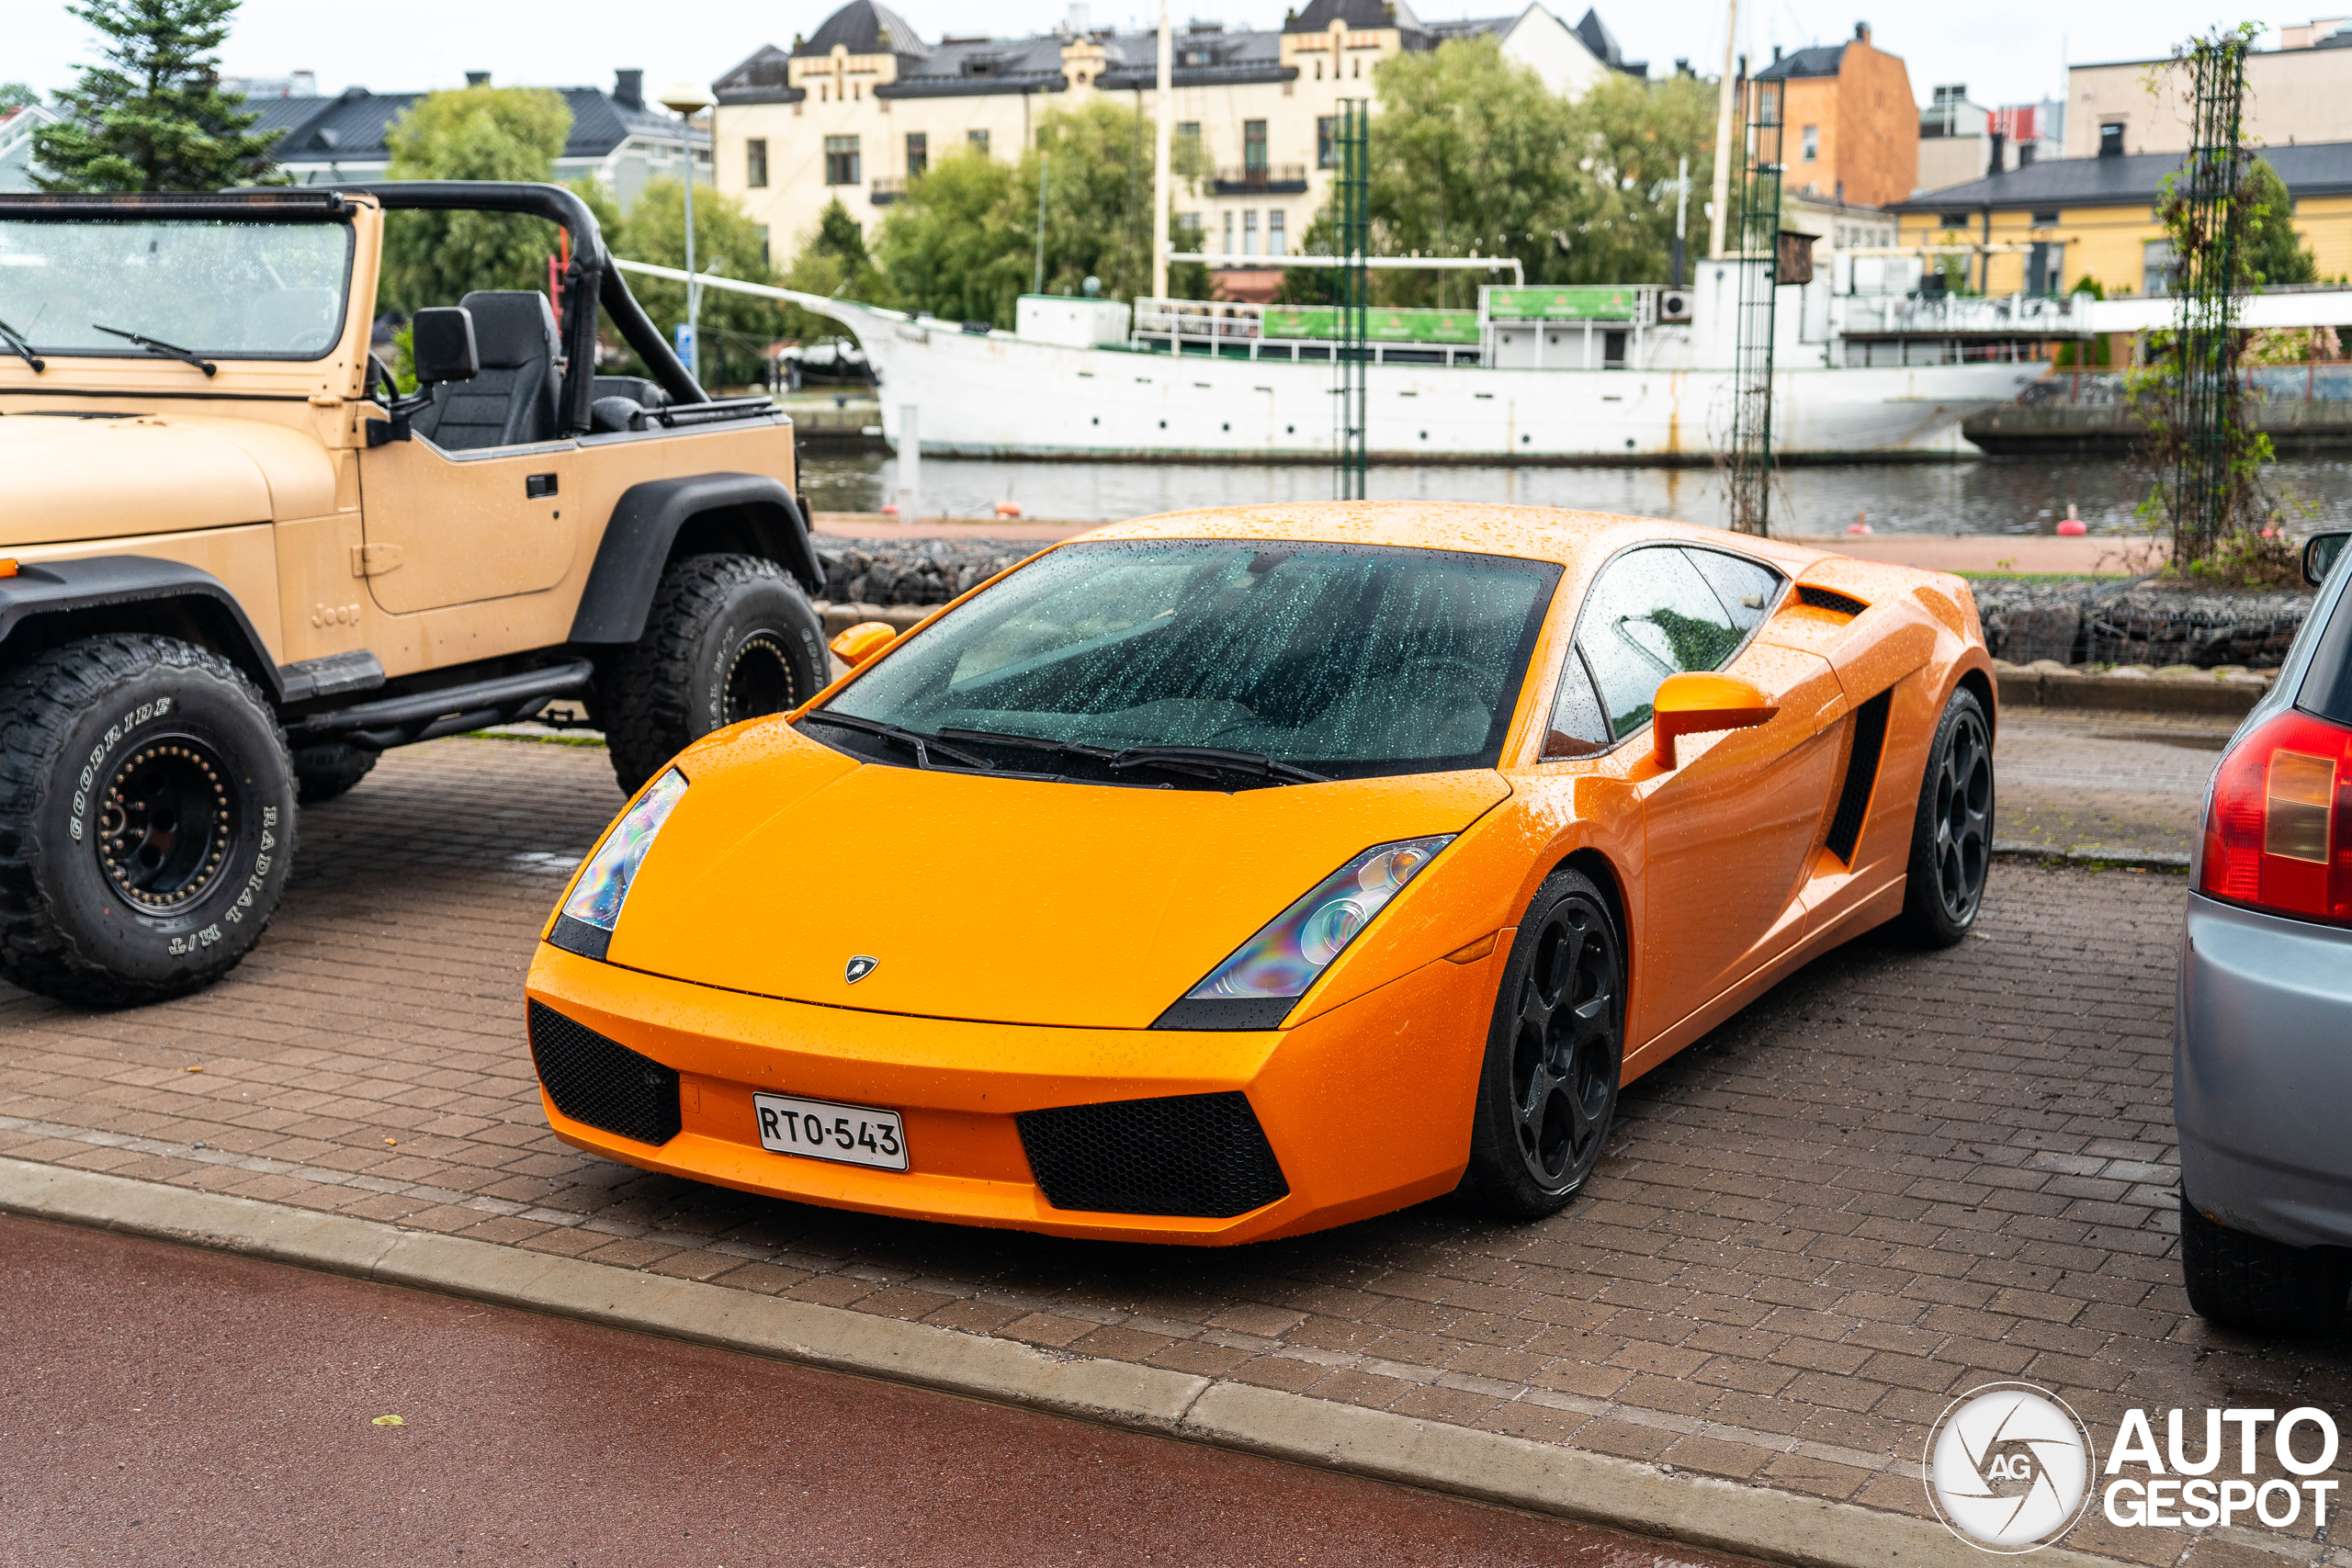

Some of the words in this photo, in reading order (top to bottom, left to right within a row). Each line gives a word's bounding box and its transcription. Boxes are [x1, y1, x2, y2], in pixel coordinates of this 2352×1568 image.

[70, 696, 171, 840] GOODRIDE
[225, 806, 277, 923] RADIAL
[168, 923, 222, 955] M/T
